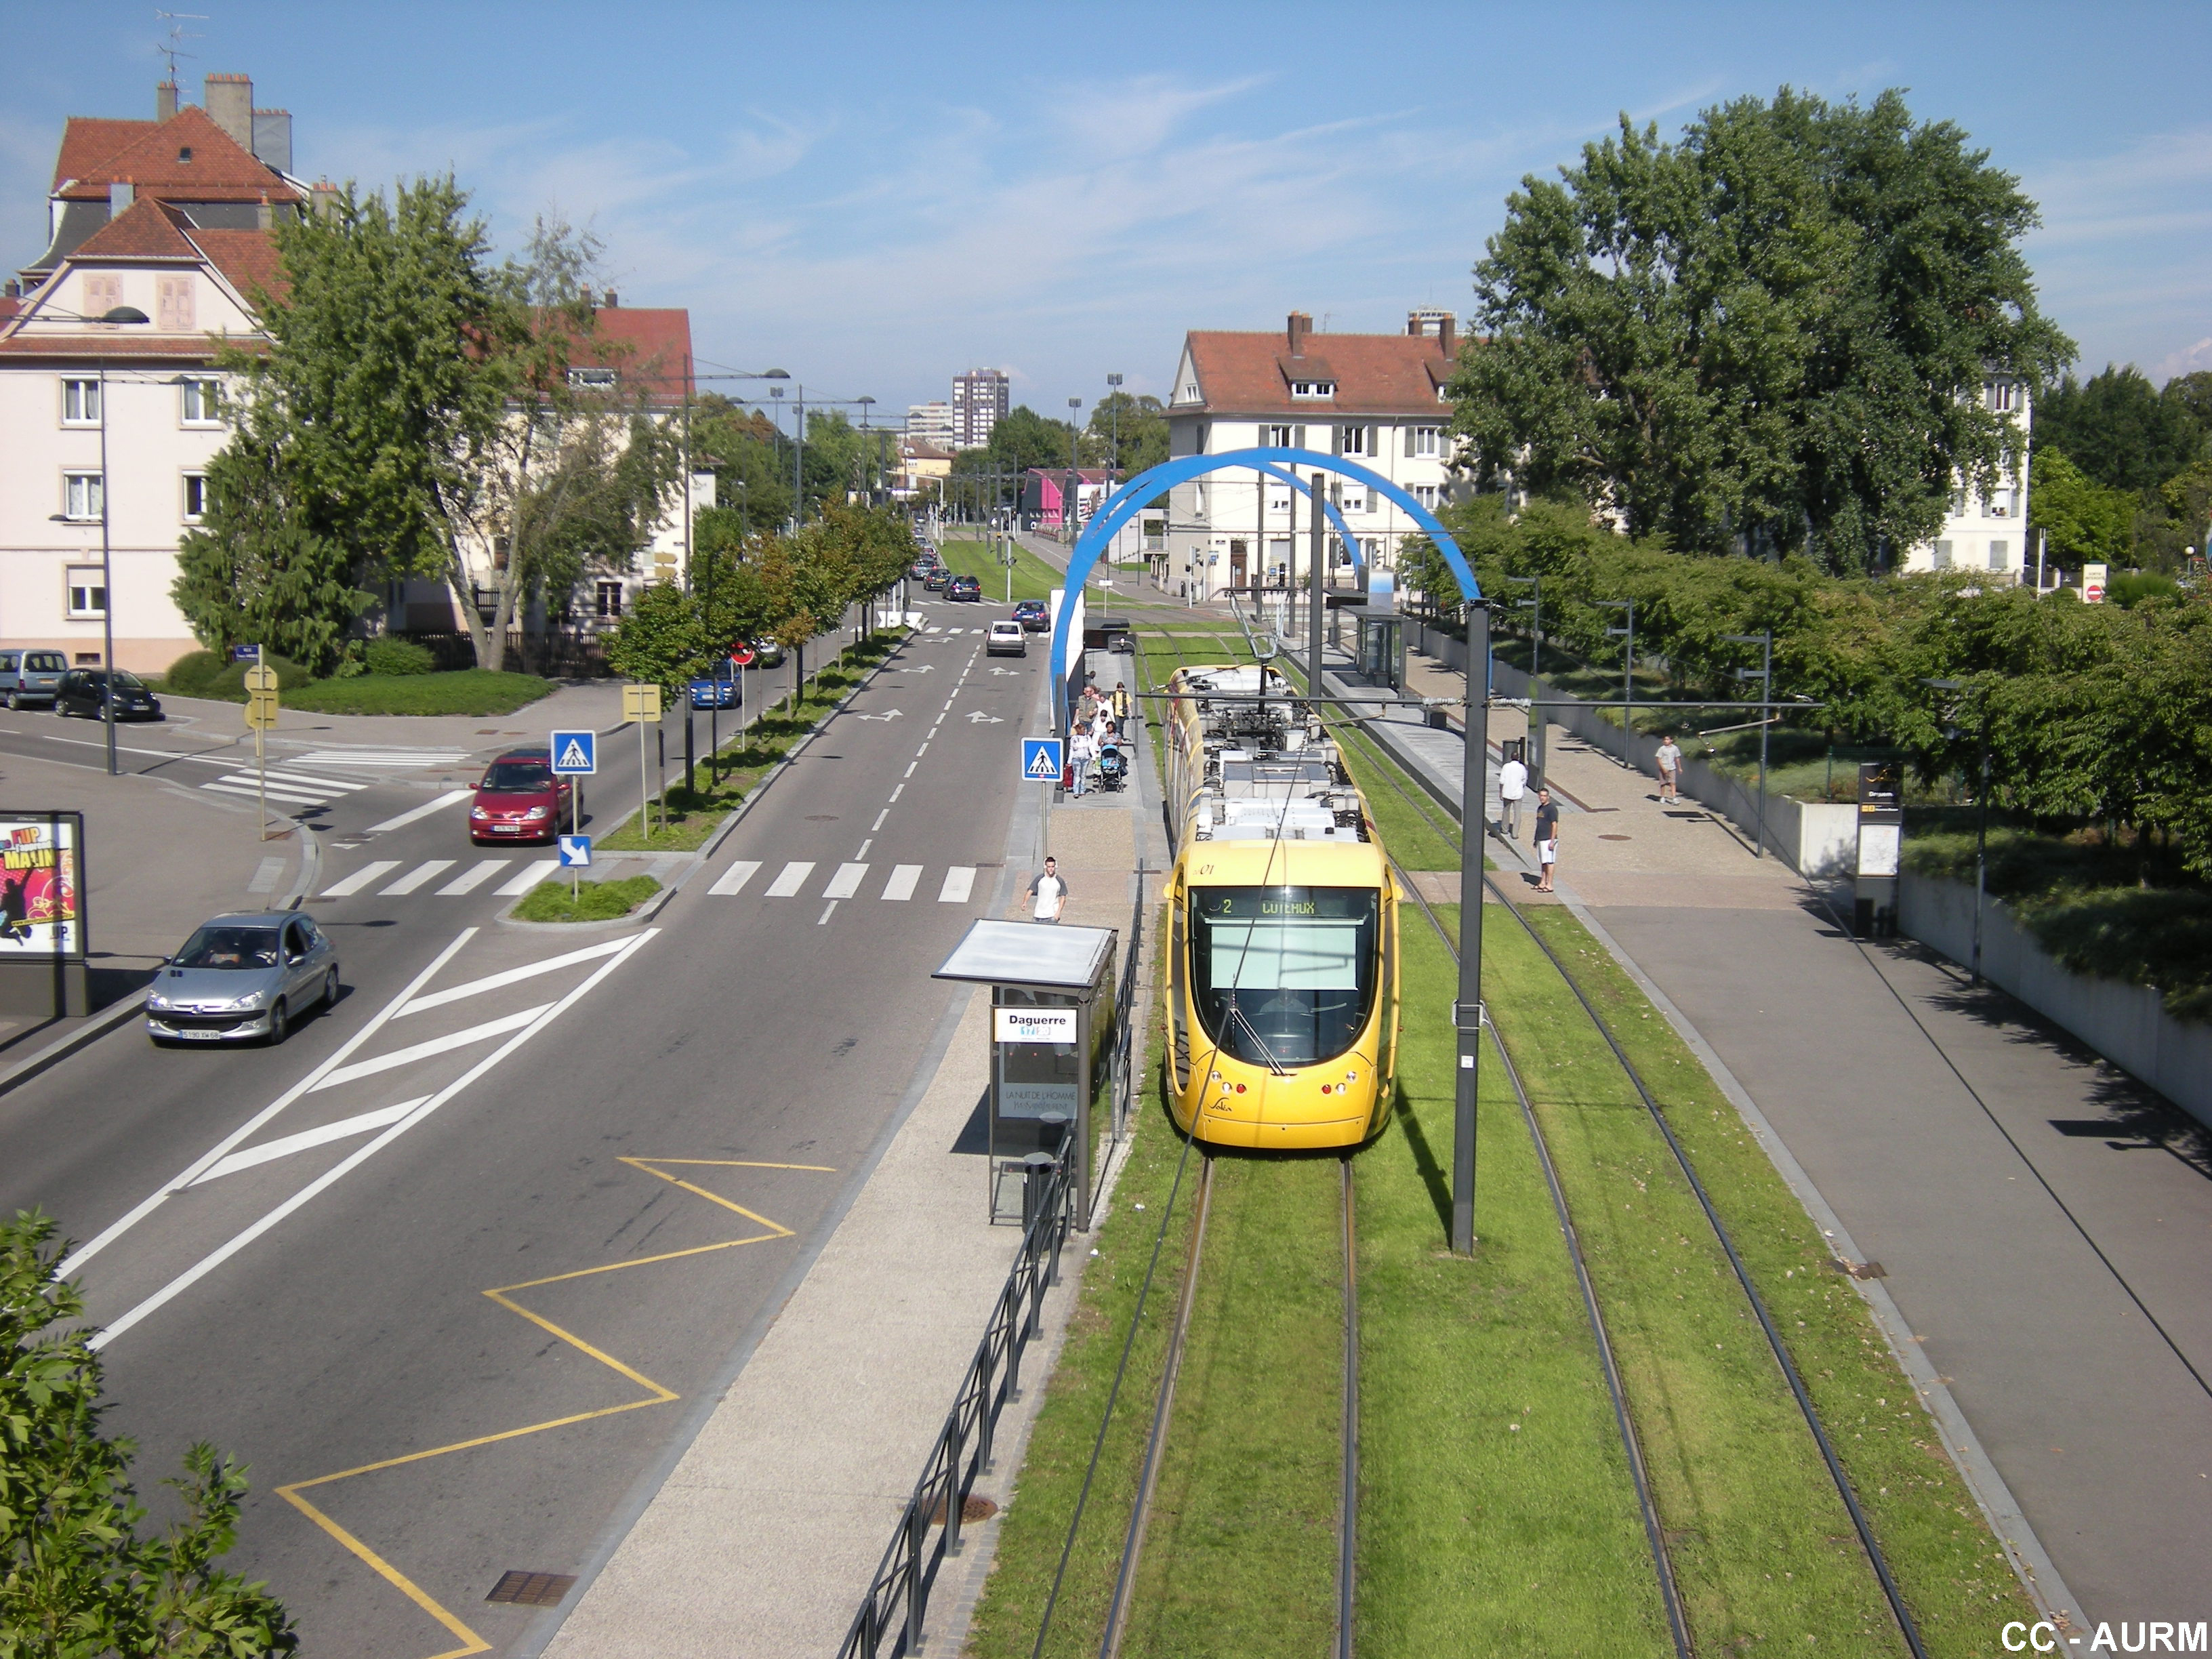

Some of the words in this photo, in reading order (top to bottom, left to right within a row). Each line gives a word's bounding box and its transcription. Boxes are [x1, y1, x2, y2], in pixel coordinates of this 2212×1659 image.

[1223, 899, 1232, 914] 2
[1009, 1015, 1066, 1026] Daguerre
[1006, 1091, 1014, 1099] LA
[1031, 1091, 1041, 1099] DE
[1042, 1092, 1076, 1100] L'HOMME
